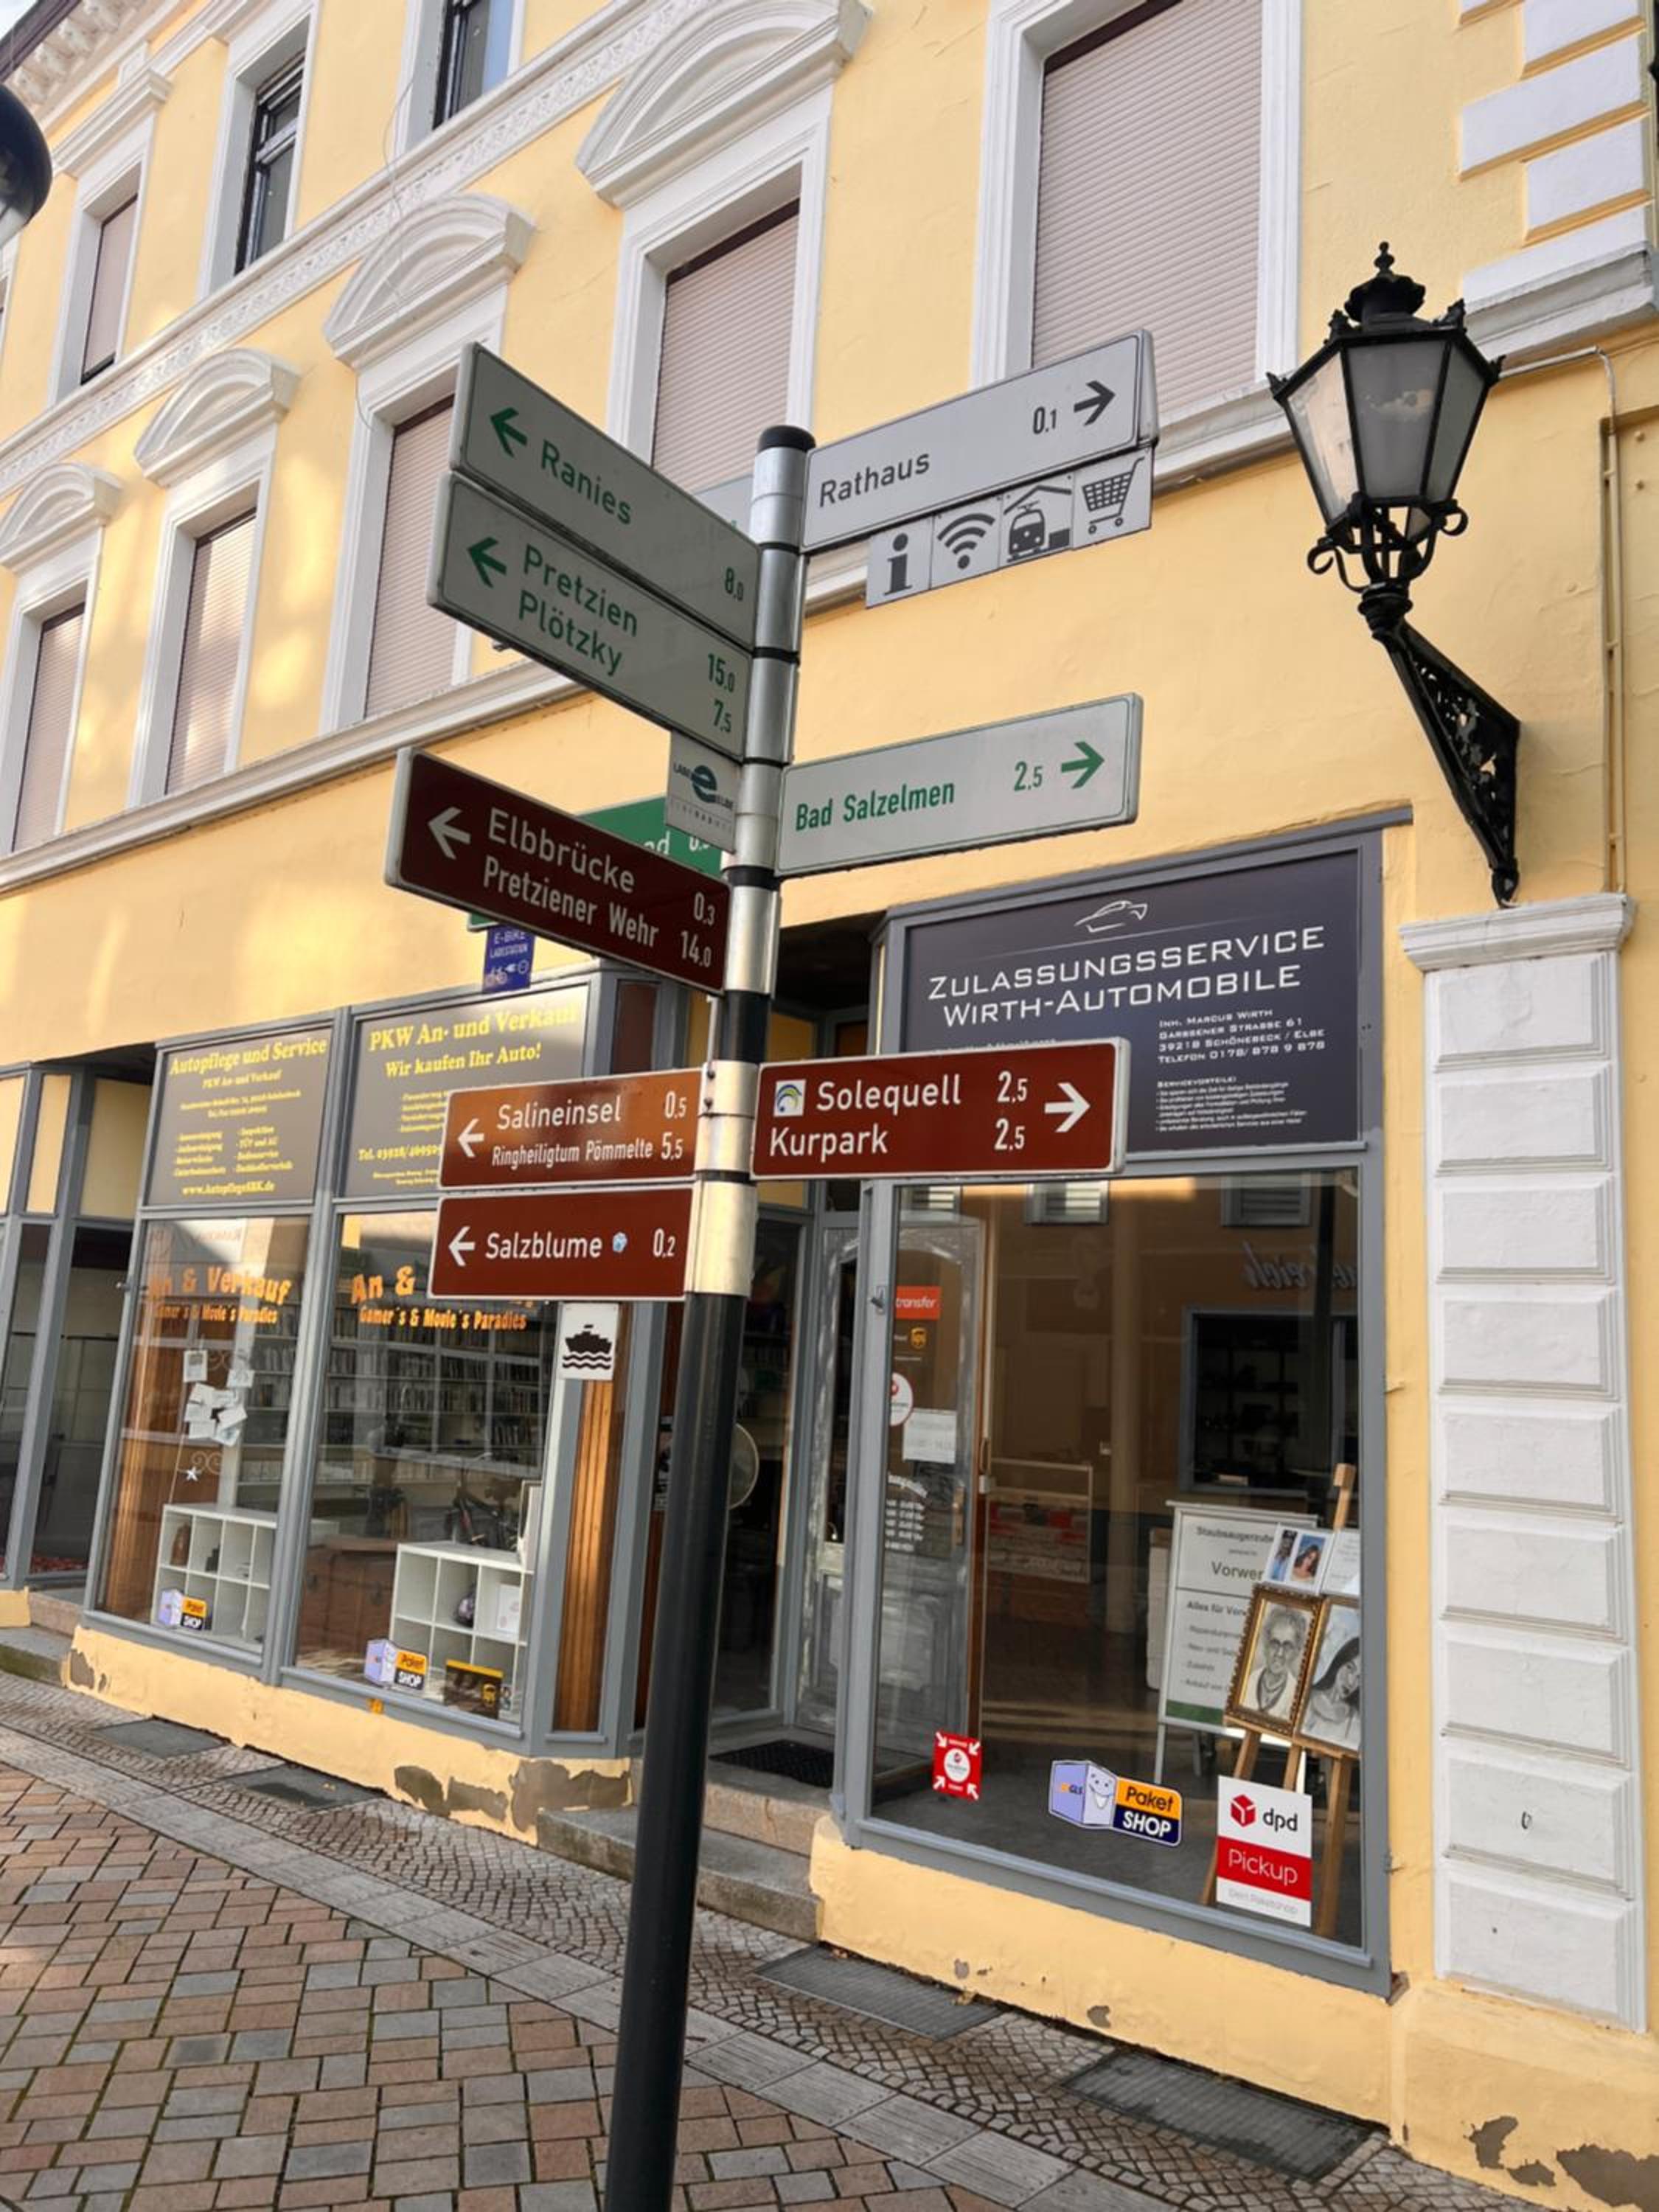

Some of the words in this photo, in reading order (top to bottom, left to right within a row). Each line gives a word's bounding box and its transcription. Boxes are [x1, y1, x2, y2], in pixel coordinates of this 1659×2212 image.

[540, 439, 632, 524] Ranies
[819, 453, 930, 507] Rathaus
[524, 544, 638, 636] Pretzien
[518, 591, 623, 677] Plötzky
[796, 799, 832, 832] Bad
[843, 780, 955, 824] Salzelmen
[488, 808, 636, 894] Elbbrücke
[484, 855, 598, 926] Pretziener
[608, 902, 660, 949] Wehr
[928, 926, 1326, 1001] ZULASSUNGSSERVICE
[943, 964, 1301, 1028] WIRTH-AUTOMOBILE
[369, 1026, 413, 1051] PKW
[453, 1016, 490, 1039] und
[495, 1003, 580, 1032] Verkauf
[170, 1051, 240, 1074] Autopflege
[243, 1043, 270, 1063] und
[272, 1037, 327, 1060] Service
[385, 1060, 411, 1078] Wir
[414, 1054, 465, 1075] kaufen
[470, 1050, 493, 1068] Ihr
[497, 1042, 542, 1063] Auto!
[496, 1097, 622, 1131] Salineinsel
[816, 1074, 961, 1116] Solequell
[492, 1141, 580, 1171] Ringheiligtum
[585, 1137, 653, 1163] Pömmelte
[770, 1123, 888, 1163] Kurpark
[485, 1232, 602, 1259] Salzblume
[207, 1265, 291, 1306] Verkauf
[351, 1273, 383, 1304] An
[395, 1265, 415, 1296] &
[474, 1310, 527, 1331] Paradies
[1211, 1561, 1264, 1580] Vorwer
[398, 1671, 422, 1687] SHOP
[1125, 1786, 1173, 1812] Paket
[1123, 1810, 1172, 1837] SHOP
[1263, 1808, 1298, 1832] dpd
[1228, 1848, 1298, 1886] Pickup
